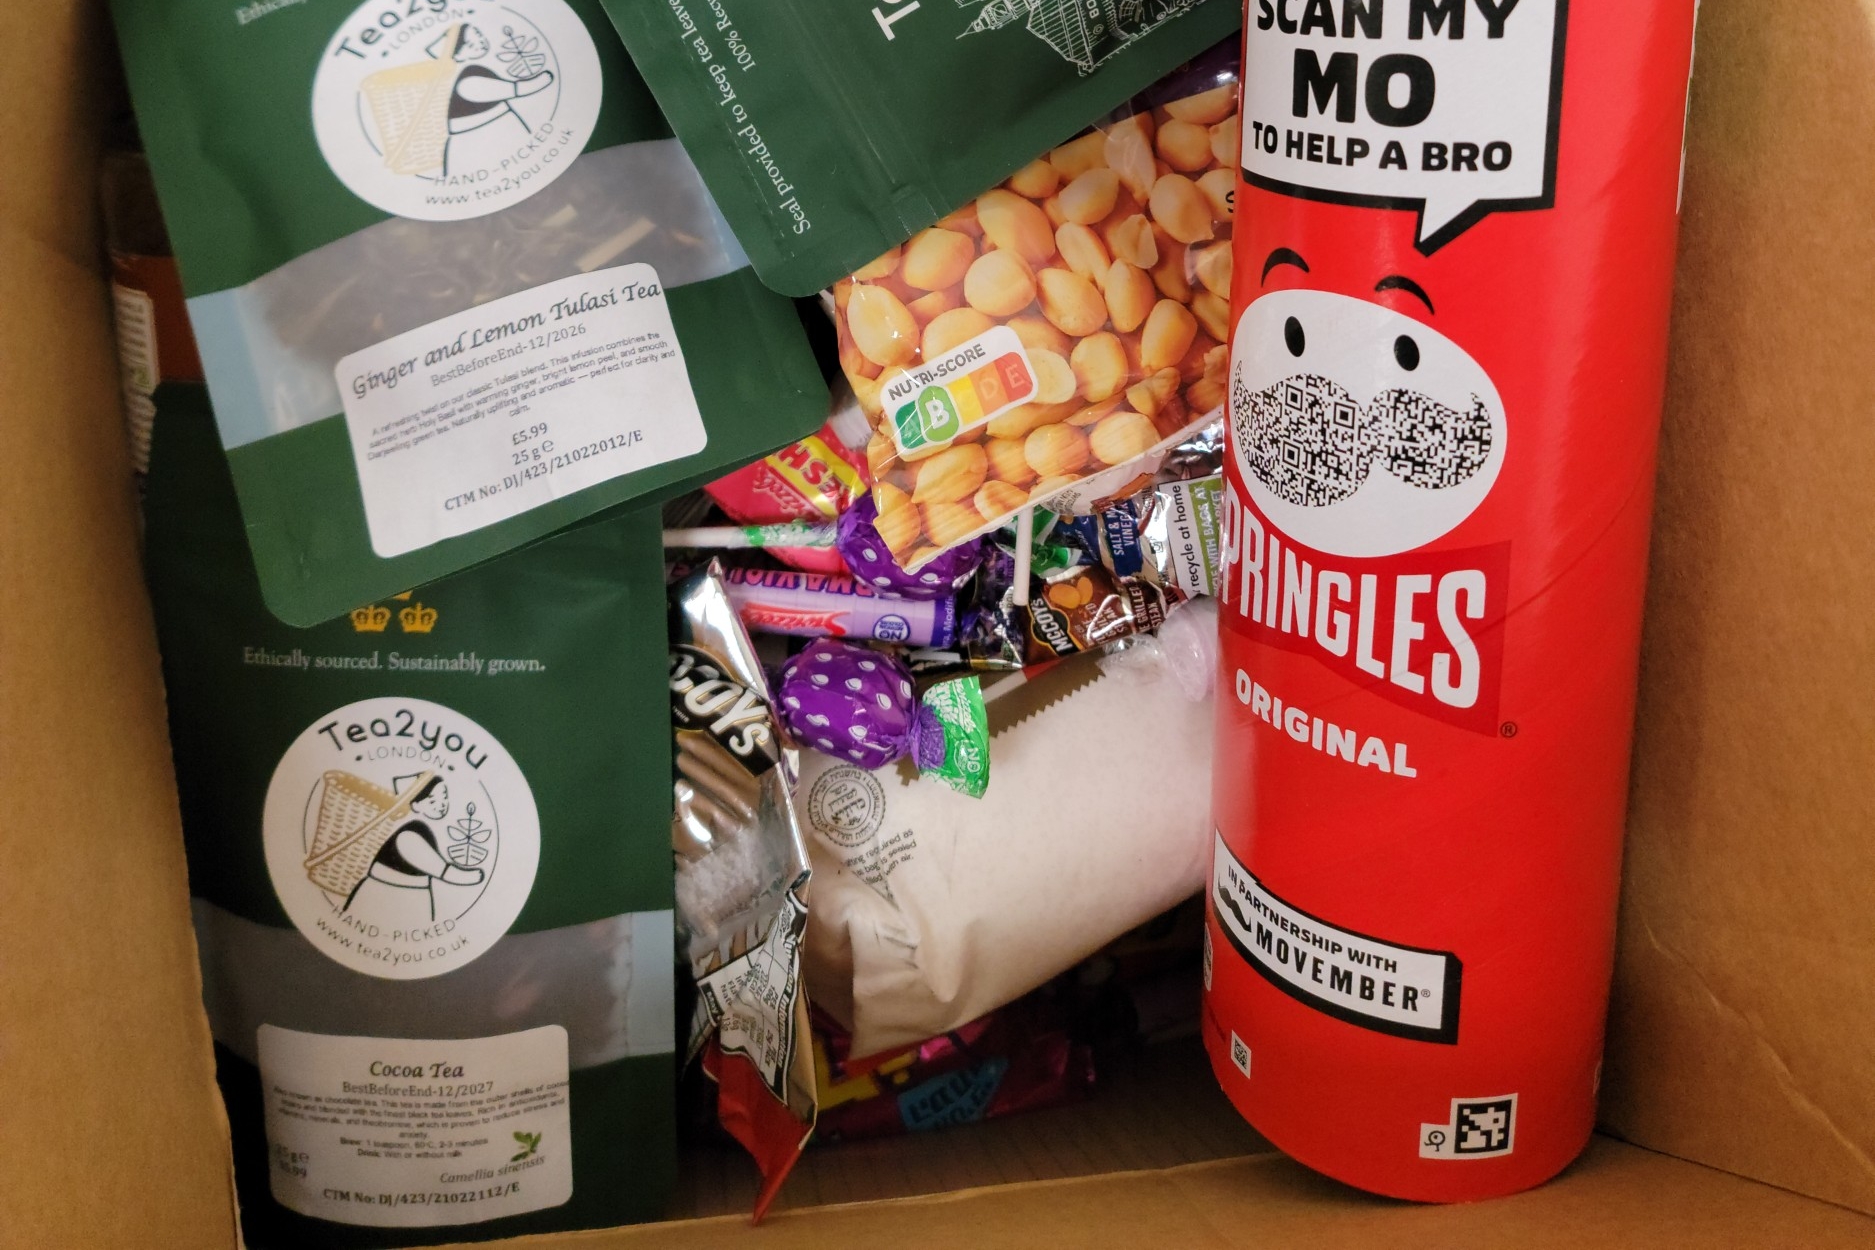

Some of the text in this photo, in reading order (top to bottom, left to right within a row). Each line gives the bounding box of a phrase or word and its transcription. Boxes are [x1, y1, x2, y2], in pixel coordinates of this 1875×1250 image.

[388, 7, 466, 52] LONDON
[692, 35, 713, 63] tea
[724, 30, 756, 72] 100%
[709, 64, 737, 107] keep
[1291, 47, 1436, 128] MO
[732, 104, 748, 124] to
[433, 120, 557, 189] HAND-PICKED
[737, 123, 794, 196] provided
[1251, 119, 1513, 172] TO HELP A BRO
[779, 196, 811, 235] Seal
[351, 281, 662, 400] Ginger and Lemon Tulasi Tea
[429, 322, 588, 388] BestBeforeEnd-12/2026
[887, 343, 986, 401] NUTRI-SCORE
[924, 363, 1026, 430] B E
[511, 421, 550, 447] £5.99
[443, 489, 477, 513] CTM
[478, 481, 503, 501] No:
[1173, 484, 1187, 526] home
[1109, 530, 1125, 557] SALT
[1180, 543, 1201, 587] recycle
[1222, 481, 1488, 711] PRINGLES
[313, 649, 384, 672] sourced.
[387, 650, 487, 675] Sustainably
[487, 655, 547, 676] grown.
[318, 708, 490, 770] Tea2you
[1234, 667, 1419, 779] ORIGINAL
[365, 747, 448, 770] LONDON
[332, 904, 458, 943] HAND-PICKED
[1226, 863, 1399, 975] IN PARTNERSHIP WITH
[342, 1081, 494, 1099] BestBeforeEnd-12/2027
[369, 1060, 465, 1079] Cocoa Tea
[439, 1155, 546, 1184] Camellia sinensis
[323, 1187, 352, 1201] CTM
[354, 1190, 377, 1205] No:
